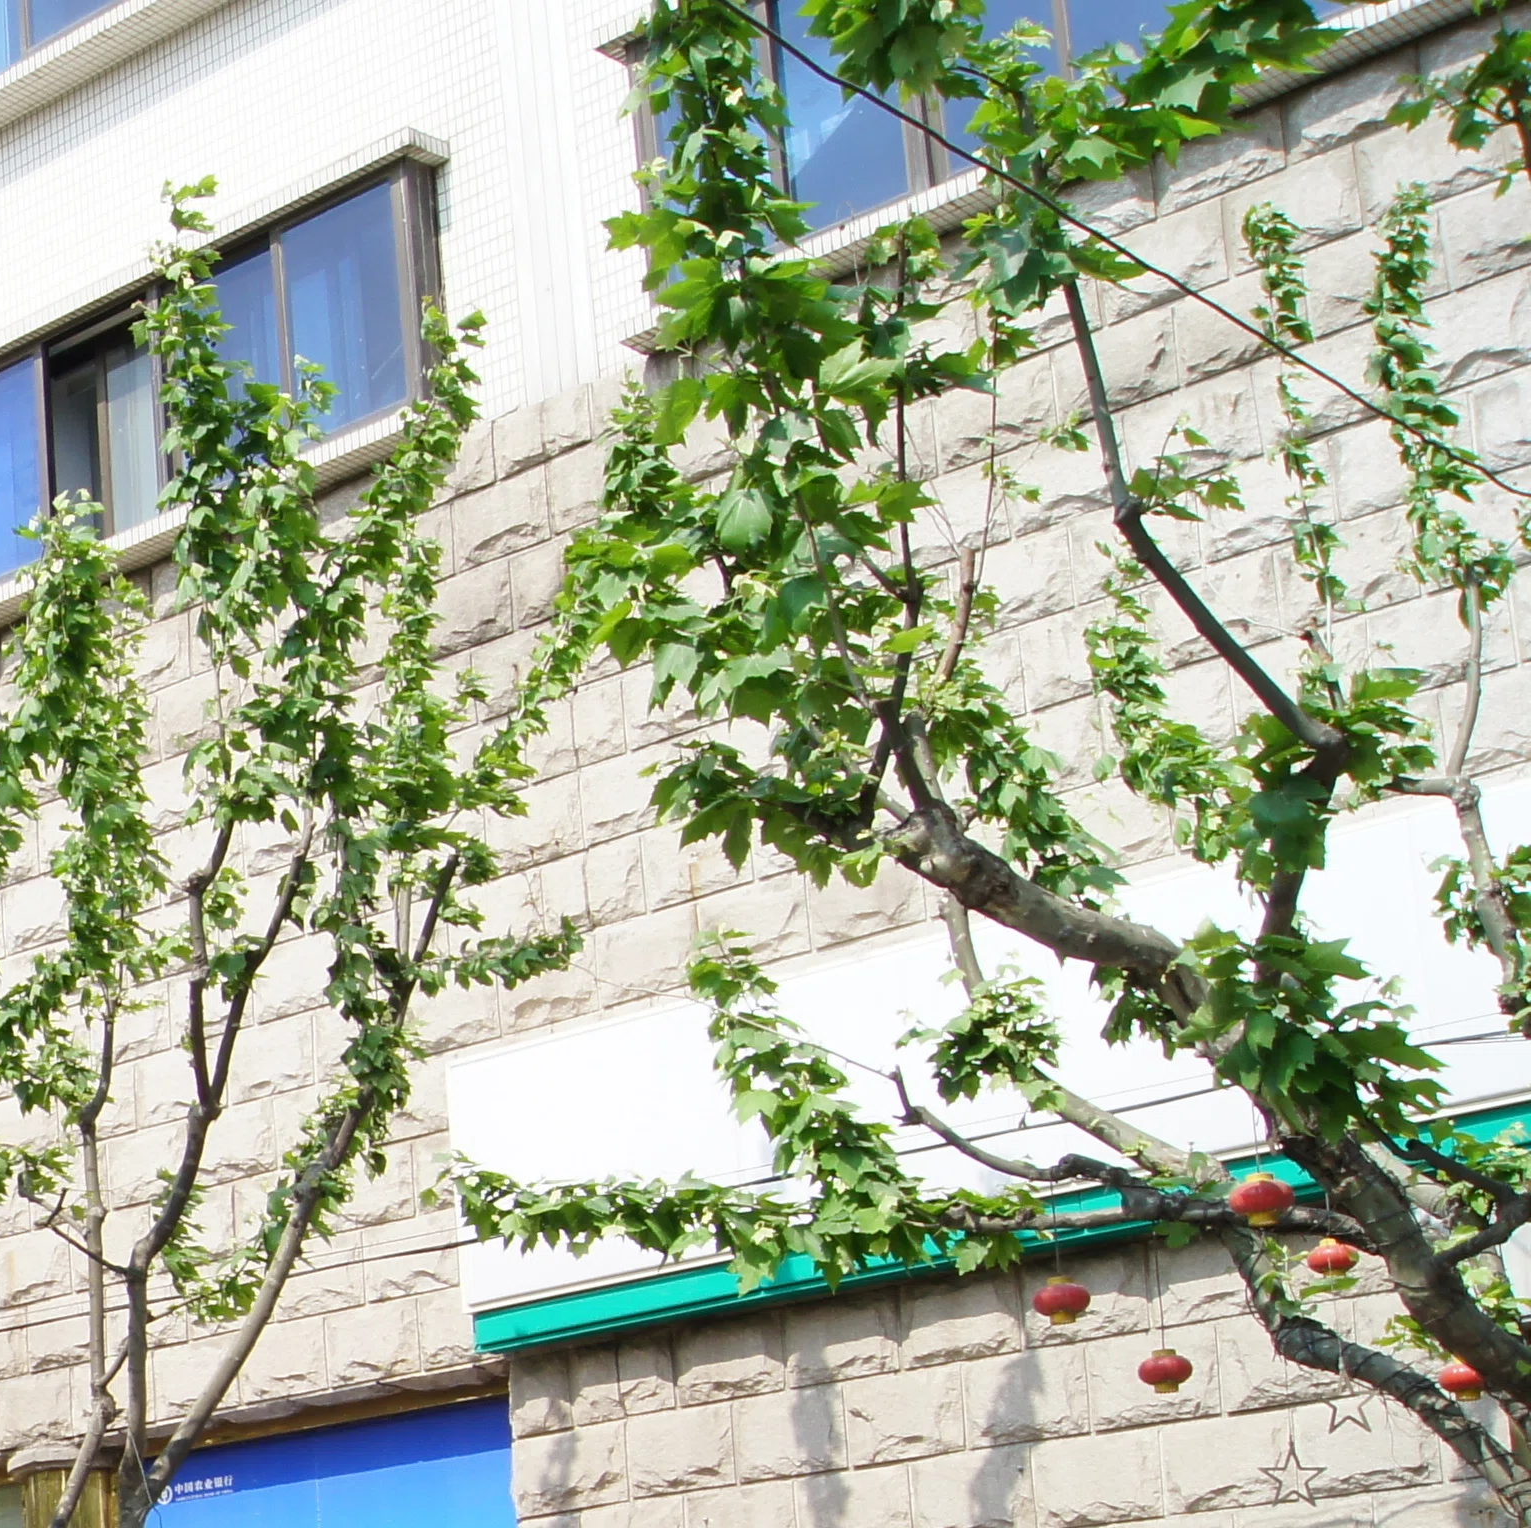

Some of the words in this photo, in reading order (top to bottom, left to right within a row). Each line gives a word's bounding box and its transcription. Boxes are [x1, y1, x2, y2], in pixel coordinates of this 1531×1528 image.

[174, 1475, 233, 1494] 中国农业银行
